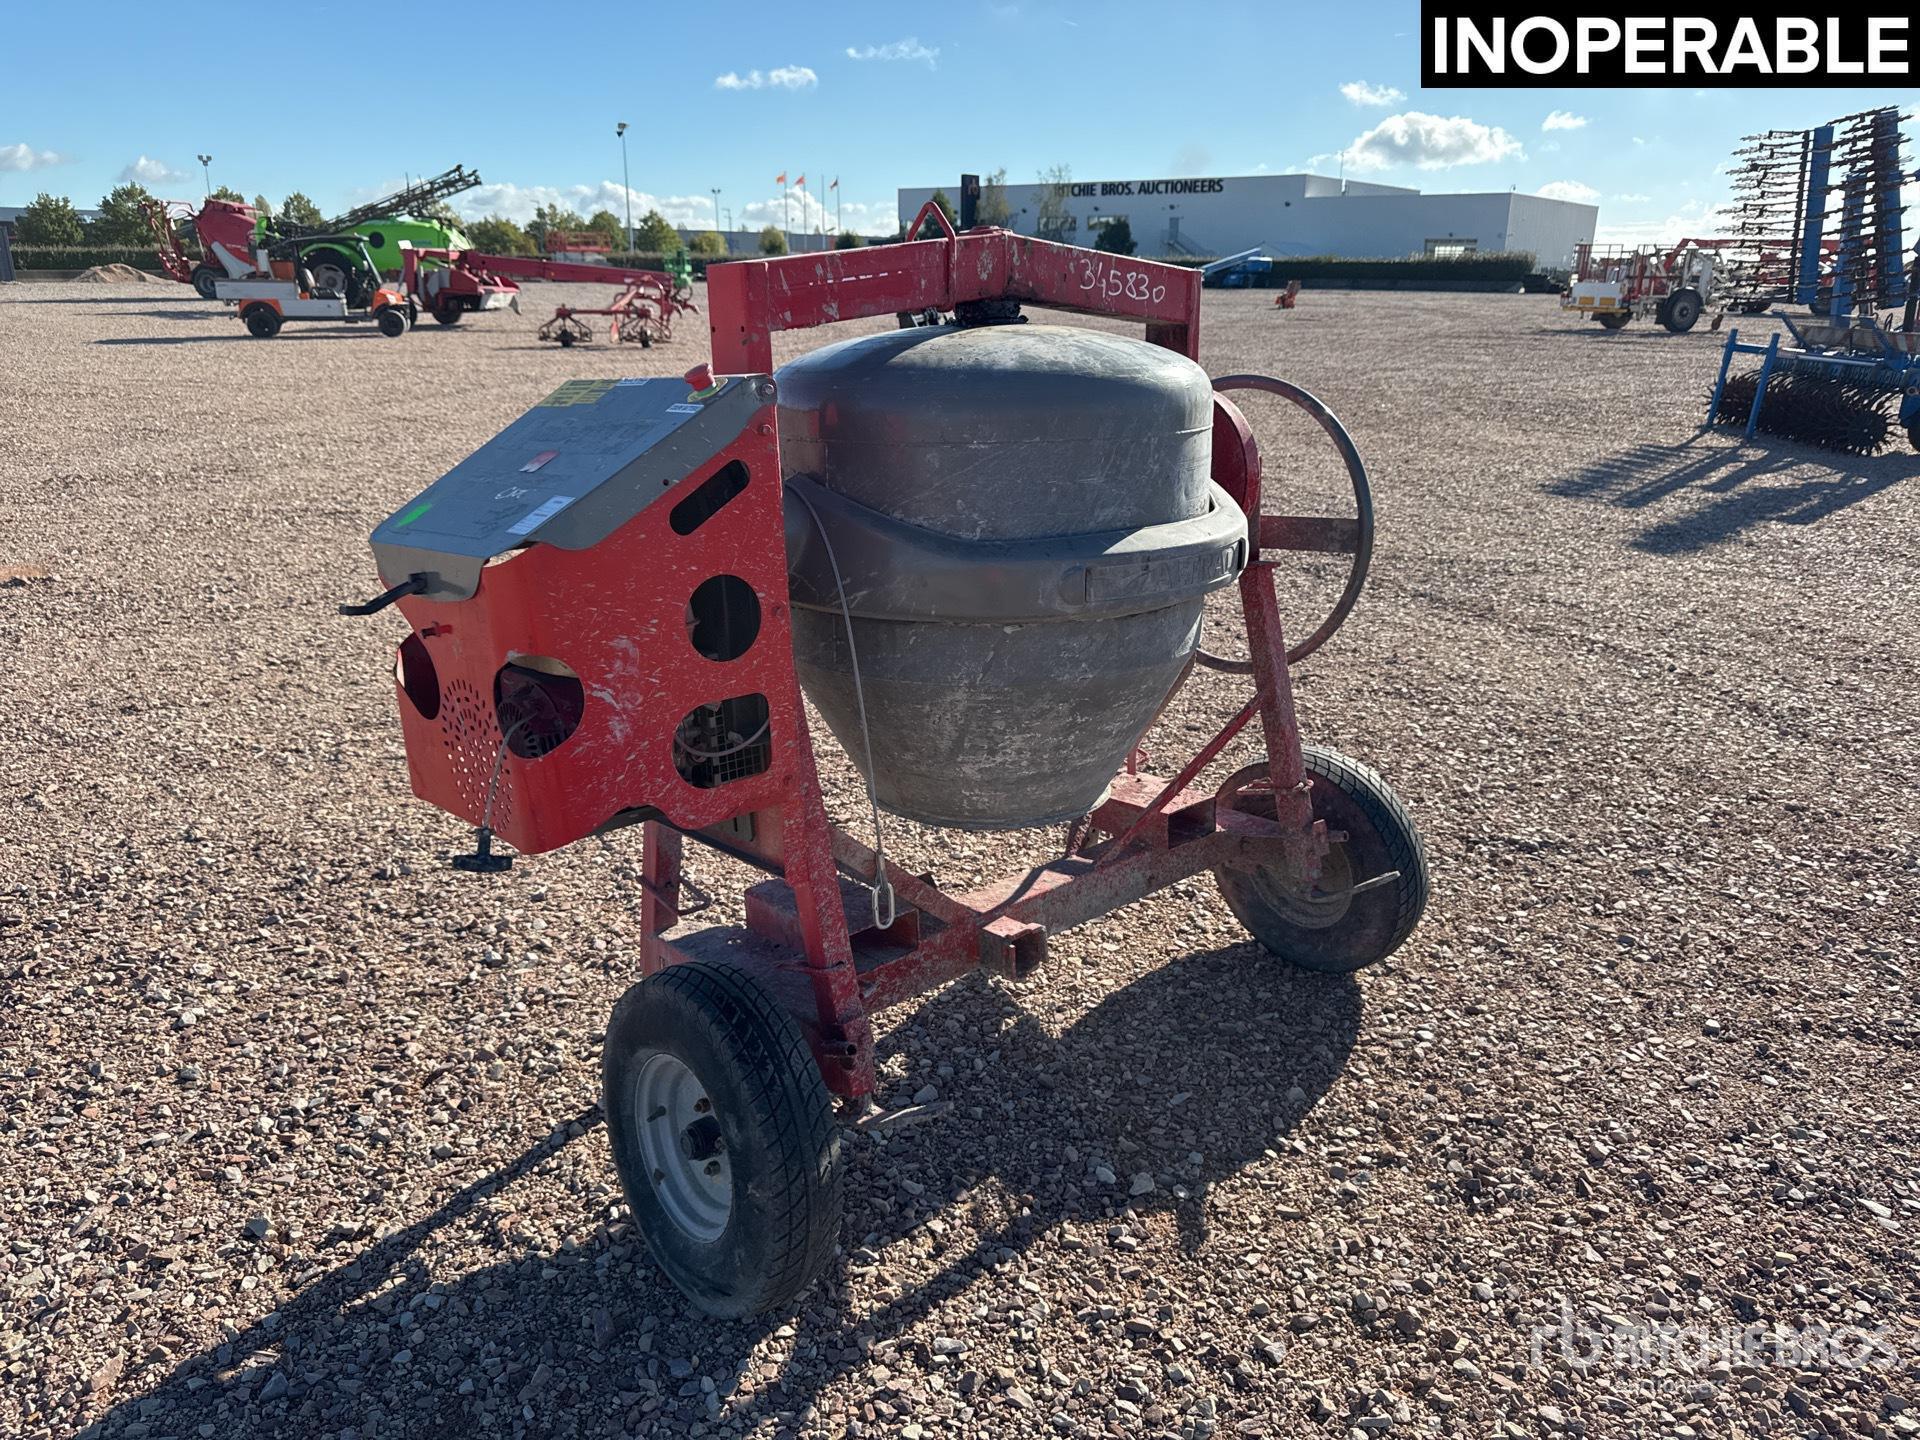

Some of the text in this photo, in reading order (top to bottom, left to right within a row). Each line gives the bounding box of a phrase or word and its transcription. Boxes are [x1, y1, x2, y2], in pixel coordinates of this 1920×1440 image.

[1101, 181, 1135, 196] BROS.
[1138, 179, 1224, 195] AUCTIONEERS
[1080, 258, 1165, 303] 345830
